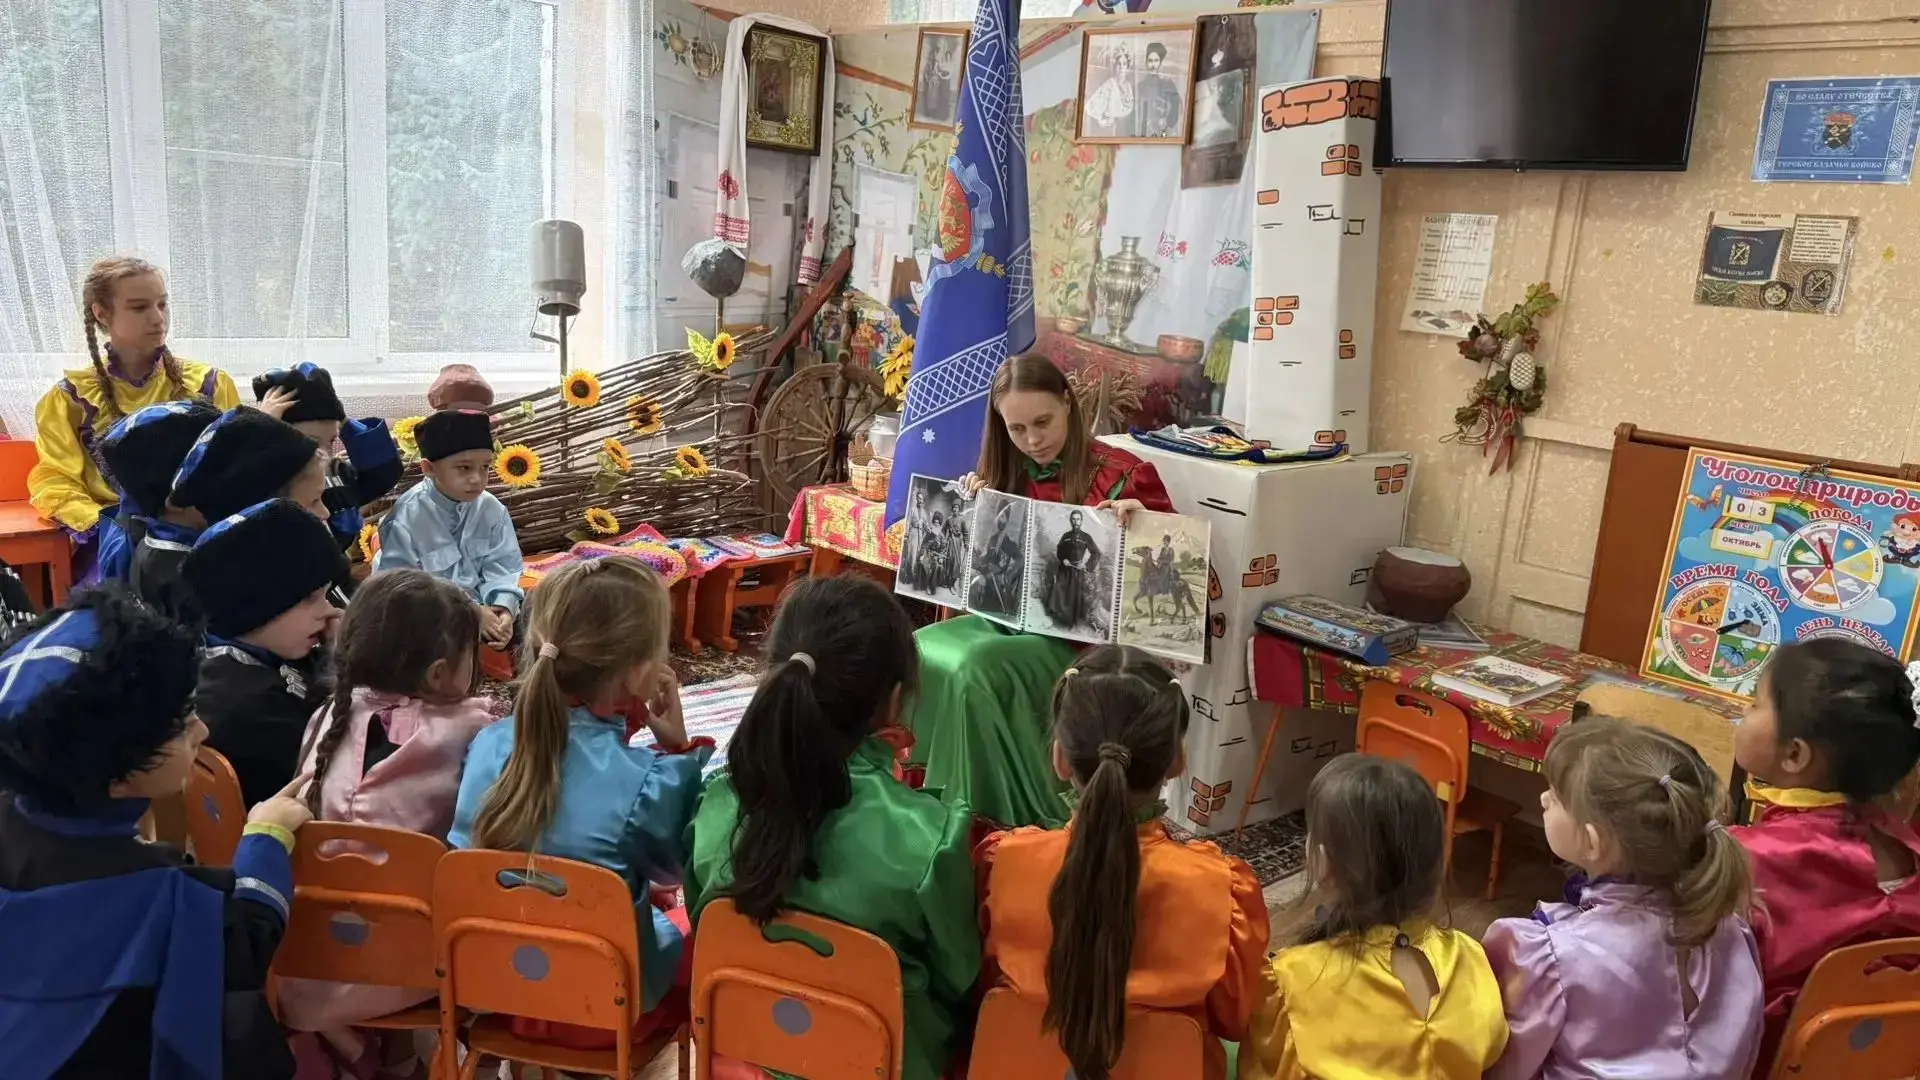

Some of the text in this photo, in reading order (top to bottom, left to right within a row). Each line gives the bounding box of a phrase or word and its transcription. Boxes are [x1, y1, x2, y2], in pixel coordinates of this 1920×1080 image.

[1814, 160, 1849, 169] КАЗАЧЬЕ
[1850, 161, 1882, 169] ВОЙСКО
[1701, 455, 1798, 491] Уголок
[1738, 487, 1770, 497] ЧИСЛО
[1736, 502, 1767, 517] 0 3
[1729, 520, 1761, 532] МЕСЯЦ
[1808, 508, 1873, 532] ПОГОДА
[1721, 536, 1762, 549] ОКТЯБРЬ
[1670, 564, 1738, 590] ВРЕМЯ
[1743, 569, 1790, 613] ГОДА
[1750, 601, 1769, 627] ЗИМА
[1795, 617, 1835, 638] ДЕНЬ
